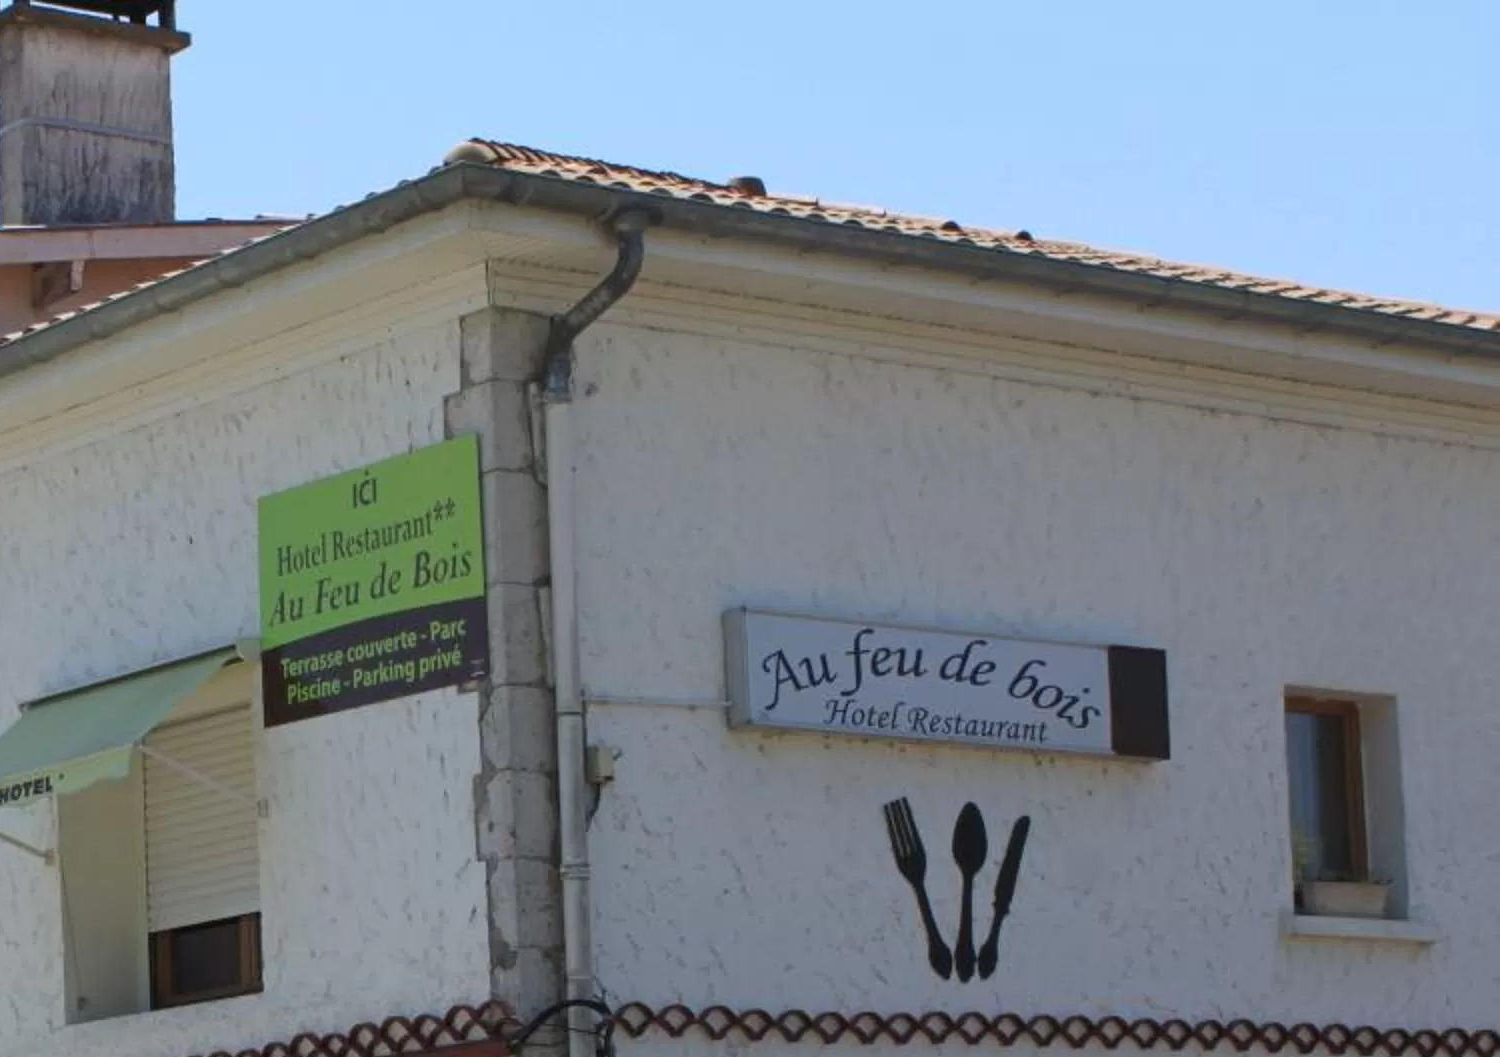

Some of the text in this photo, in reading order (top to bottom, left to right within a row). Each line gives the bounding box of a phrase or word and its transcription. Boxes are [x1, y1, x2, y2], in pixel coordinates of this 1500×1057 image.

[268, 542, 474, 628] Au Feu de Bois
[276, 533, 328, 577] Hotel
[280, 648, 344, 680] Terrasse
[347, 627, 418, 664] couverte
[429, 617, 468, 642] Parc
[287, 675, 342, 705] Piscine
[352, 660, 416, 688] Parking
[419, 645, 463, 677] privé
[761, 627, 1102, 730] Au feu de bois
[824, 698, 1050, 744] Hotel Restaurant
